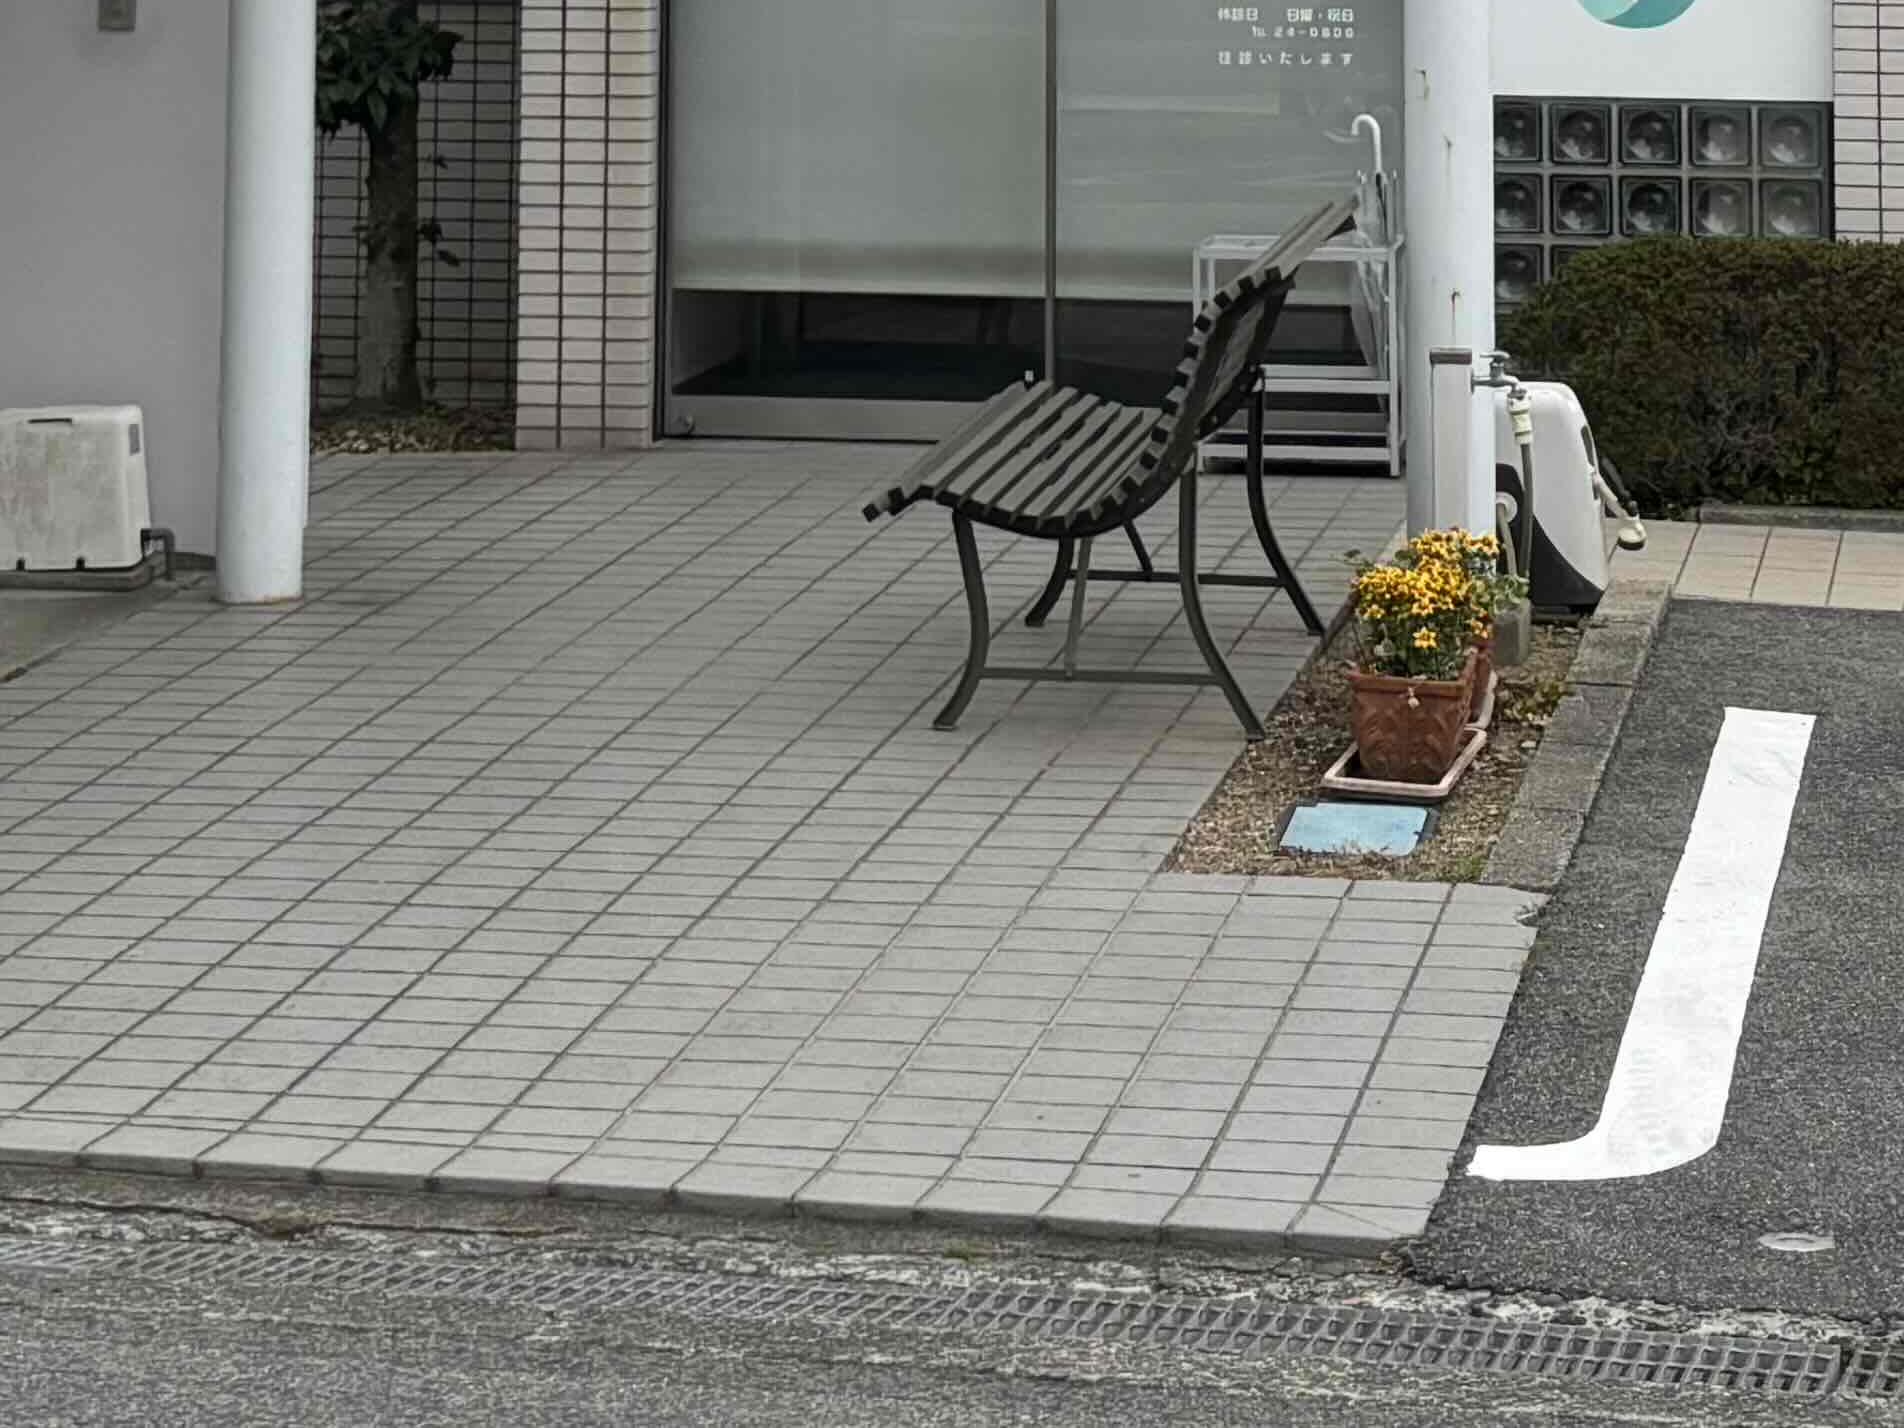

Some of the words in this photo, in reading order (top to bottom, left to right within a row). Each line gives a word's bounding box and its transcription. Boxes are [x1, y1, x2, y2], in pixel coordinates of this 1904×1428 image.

[1218, 7, 1258, 22] 休診日
[1218, 50, 1353, 66] 往診いたします
